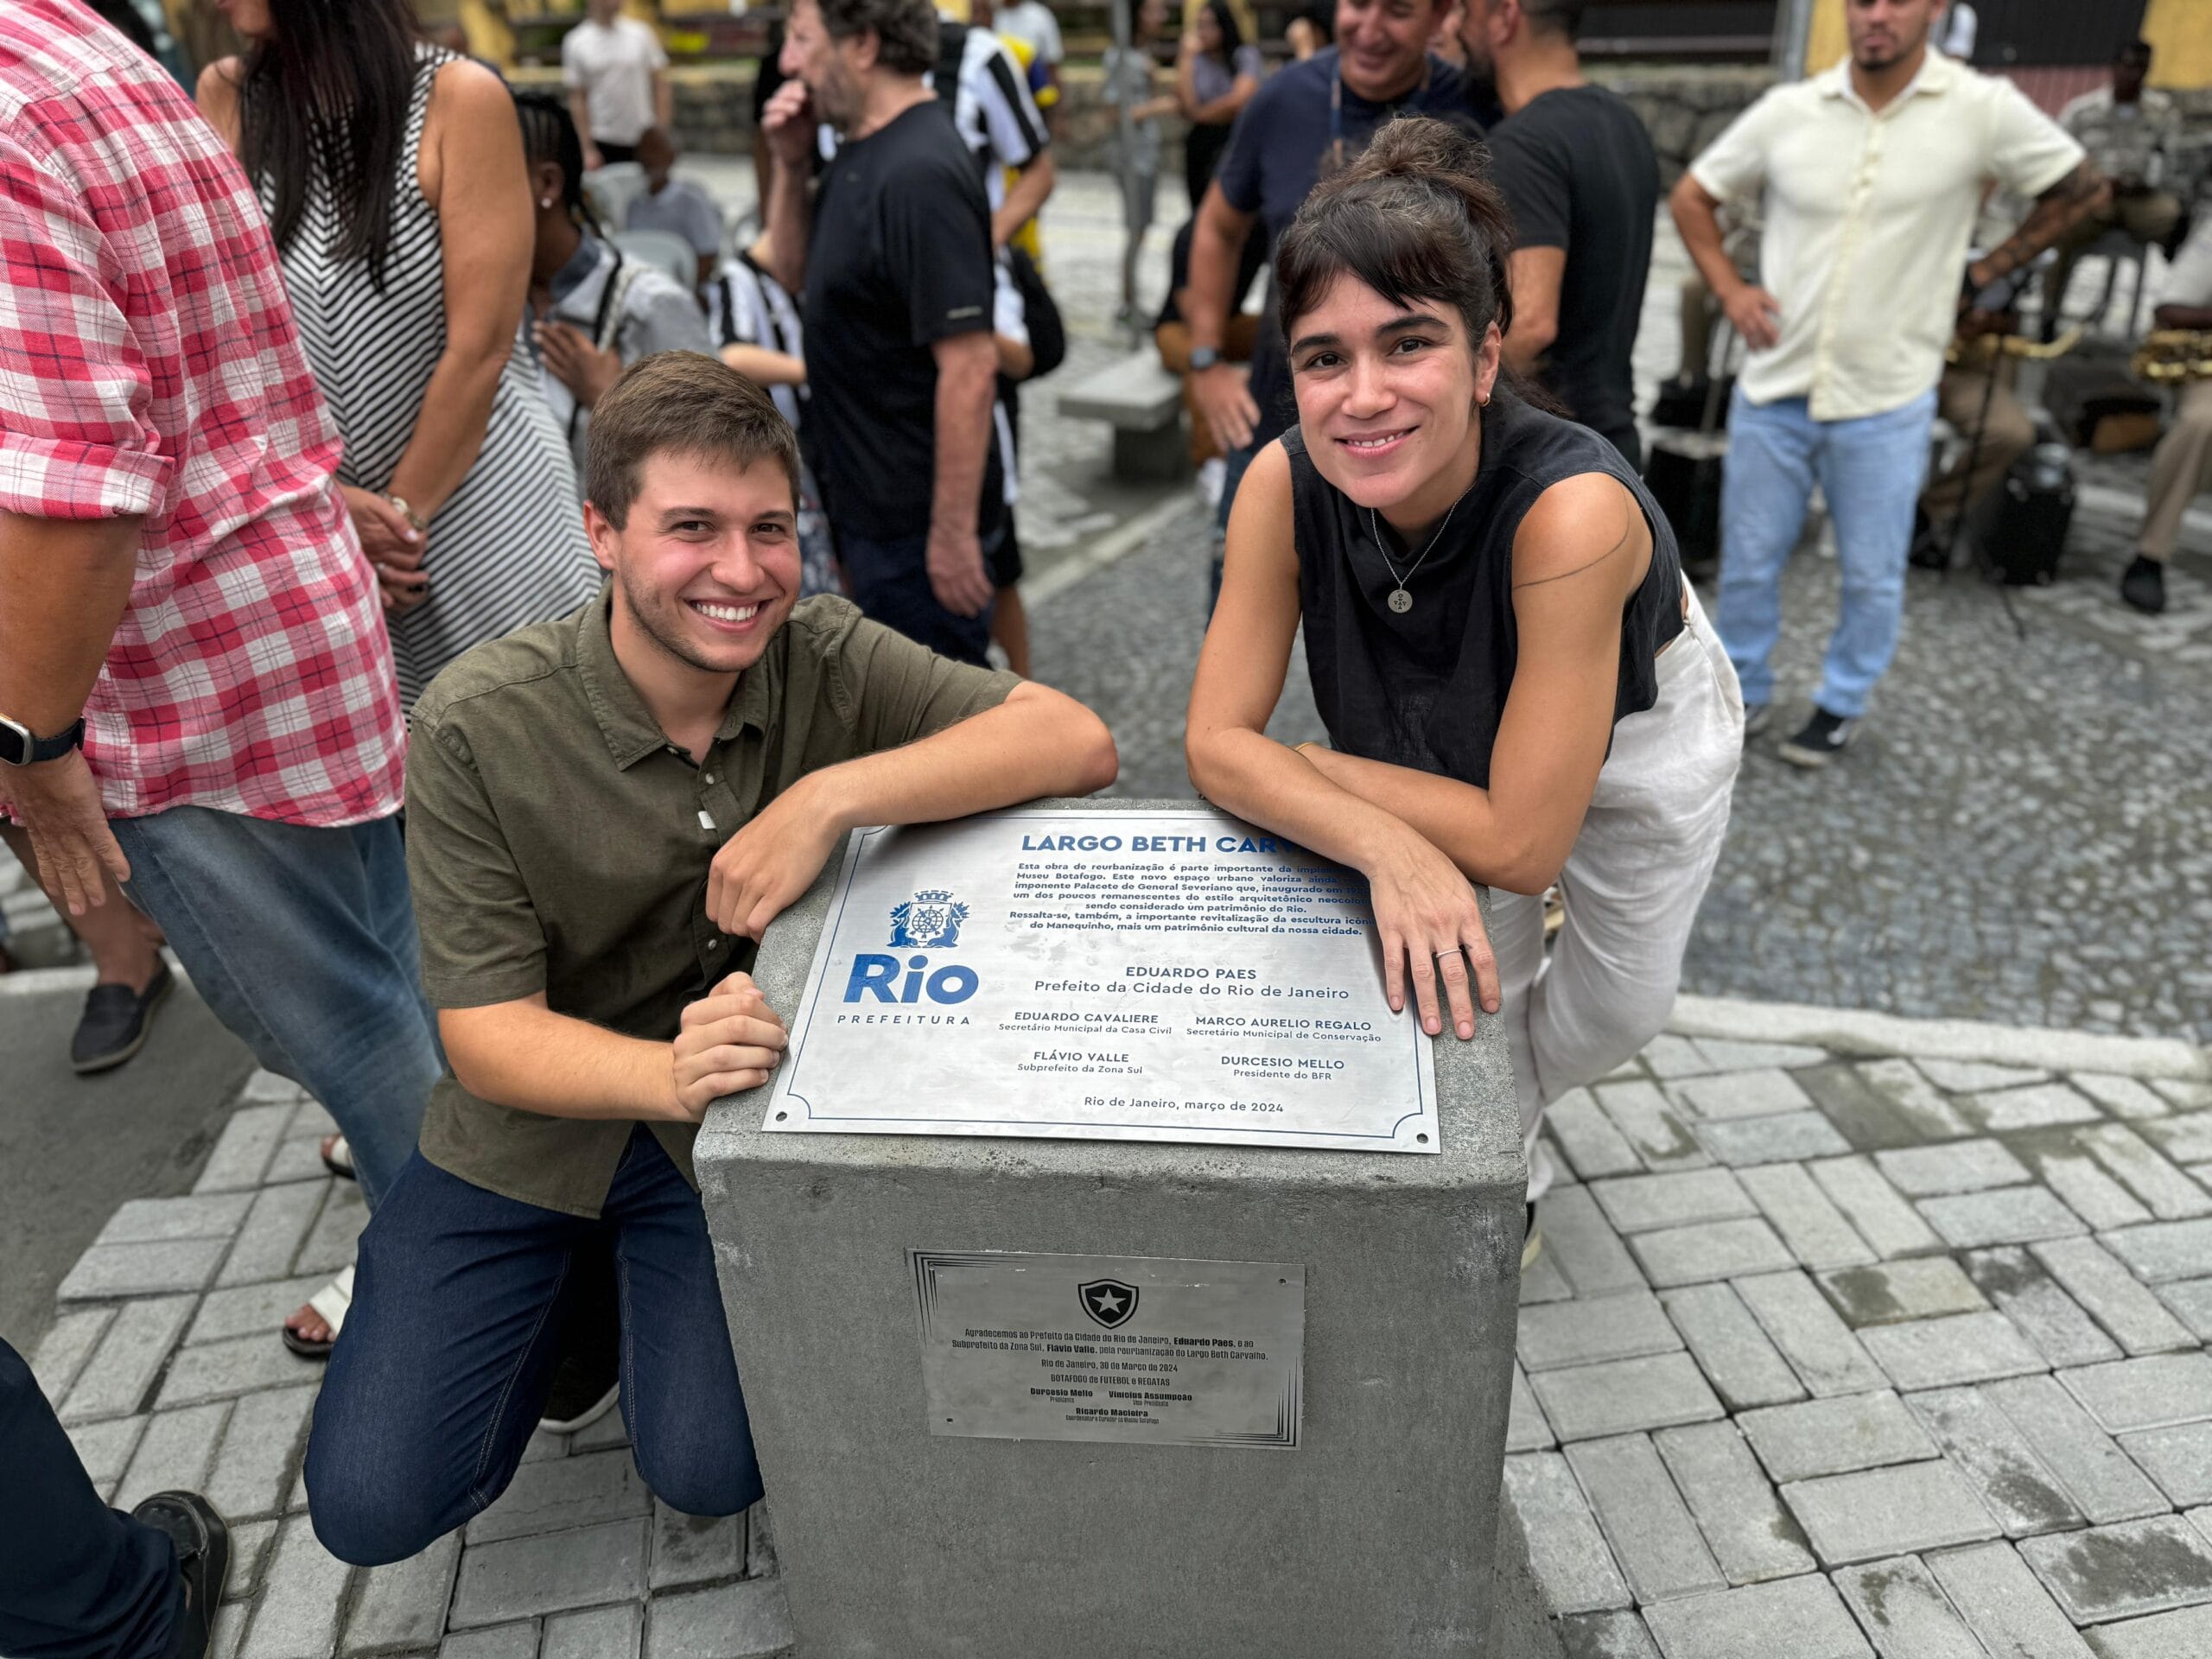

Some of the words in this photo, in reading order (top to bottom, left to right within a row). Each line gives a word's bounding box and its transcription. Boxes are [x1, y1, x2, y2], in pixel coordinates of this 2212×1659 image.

[1022, 836, 1122, 852] LARGO
[1132, 836, 1205, 852] BETH
[1217, 836, 1303, 854] CARV
[1091, 863, 1164, 872] reurbanização
[1214, 865, 1273, 874] importante
[1056, 872, 1106, 880] Botafogo.
[1015, 881, 1071, 890] imponente
[1262, 885, 1323, 894] inaugurado
[1185, 893, 1200, 902] do
[1205, 893, 1234, 902] estilo
[1240, 894, 1313, 904] arquitetônico
[1207, 904, 1267, 912] patrimônio
[1010, 912, 1071, 920] Ressalta-se,
[1075, 912, 1122, 922] também,
[1136, 913, 1197, 922] importante
[1201, 914, 1269, 924] revitalização
[1291, 916, 1341, 925] escultura
[1345, 916, 1375, 926] icôni
[1046, 922, 1114, 931] Manequinho,
[1165, 924, 1224, 932] patrimônio
[1322, 926, 1363, 936] cidade.
[843, 954, 979, 1005] Rio
[1127, 967, 1210, 978] EDUARDO
[1216, 969, 1256, 980] PAES
[1035, 981, 1101, 992] Prefeito
[1107, 982, 1127, 993] da
[1134, 982, 1193, 995] Cidade
[1199, 983, 1221, 995] do
[1228, 985, 1255, 996] Rio
[1261, 985, 1282, 997] de
[1288, 988, 1349, 999] Janeiro
[837, 1014, 969, 1025] PREFEITURA
[1015, 1012, 1080, 1021] EDUARDO
[1084, 1014, 1159, 1024] CAVALIERE
[1196, 1017, 1246, 1027] MARCO
[1251, 1019, 1311, 1028] AURELIO
[1315, 1020, 1371, 1031] REGALO
[1054, 1025, 1103, 1033] Municipal
[1187, 1028, 1240, 1037] Secretário
[1243, 1030, 1293, 1039] Municipal
[1313, 1033, 1382, 1043] Conservação
[1034, 1050, 1083, 1061] FLÁVIO
[1088, 1053, 1129, 1063] VALLE
[1018, 1064, 1078, 1072] Subprefeito
[1222, 1057, 1294, 1067] DURCESIO
[1298, 1059, 1344, 1070] MELLO
[1234, 1070, 1290, 1078] Presidente
[1084, 1096, 1105, 1106] Rio
[1109, 1097, 1126, 1107] de
[1130, 1099, 1179, 1110] Janeiro,
[1185, 1103, 1225, 1112] março
[1230, 1101, 1247, 1111] de
[1251, 1103, 1283, 1112] 2024
[965, 1329, 1018, 1338] Agradecemos
[1030, 1332, 1063, 1340] Prefeito
[1065, 1332, 1074, 1341] da
[1075, 1333, 1101, 1342] Cidade
[1103, 1334, 1112, 1343] do
[1127, 1335, 1137, 1344] de
[1138, 1336, 1172, 1345] Janeiro,
[1174, 1338, 1211, 1346] Eduardo
[1212, 1338, 1236, 1348] Paes,
[952, 1340, 998, 1350] Subprefeito
[999, 1342, 1009, 1351] da
[1010, 1342, 1028, 1351] Zona
[1030, 1343, 1045, 1351] Sul,
[1074, 1345, 1098, 1354] Valle,
[1099, 1346, 1116, 1355] pela
[1176, 1349, 1185, 1357] do
[1187, 1350, 1210, 1359] Largo
[1211, 1351, 1229, 1359] Beth
[1230, 1351, 1268, 1360] Carvalho.
[1041, 1359, 1054, 1368] Rio
[1066, 1360, 1098, 1370] Janeiro,
[1110, 1362, 1120, 1370] de
[1122, 1363, 1147, 1371] Março
[1148, 1363, 1158, 1372] de
[1160, 1363, 1178, 1372] 2024
[1051, 1375, 1088, 1383] BOTAFOGO
[1089, 1376, 1098, 1384] de
[1100, 1376, 1130, 1385] FUTEBOL
[1138, 1377, 1170, 1387] REGATAS
[1031, 1388, 1069, 1396] Durcesio
[1076, 1408, 1109, 1416] Ricardo
